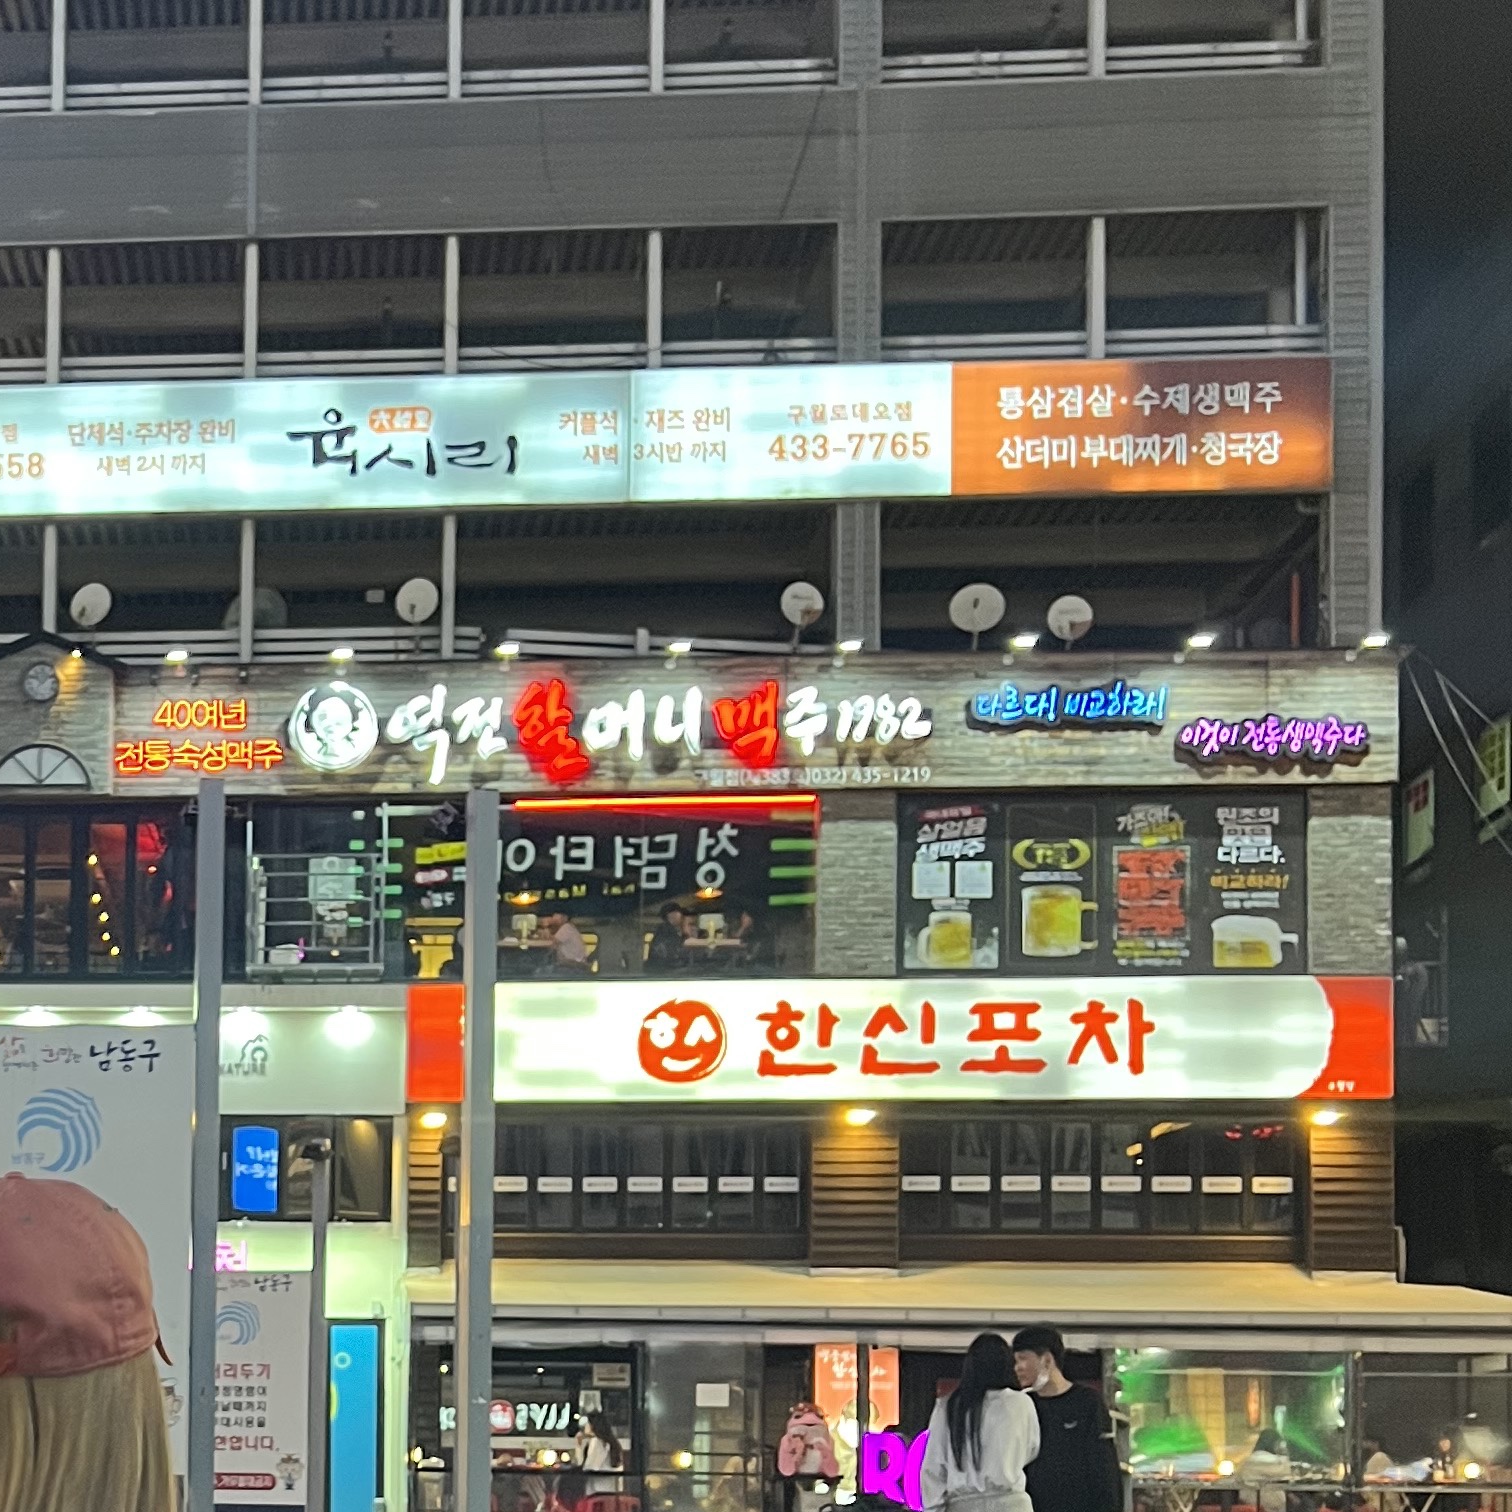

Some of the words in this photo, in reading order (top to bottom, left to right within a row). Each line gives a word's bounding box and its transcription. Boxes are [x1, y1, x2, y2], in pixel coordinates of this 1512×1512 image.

[197, 419, 236, 444] 완비
[558, 409, 619, 437] 커플석
[692, 406, 731, 432] 완비
[690, 441, 727, 463] 까지
[768, 431, 931, 462] 433-7765
[171, 453, 207, 475] 까지
[153, 700, 247, 731] 40여년
[387, 678, 829, 786] 역전할머니맥주
[836, 692, 932, 743] 1982
[852, 766, 931, 784] 435-1219
[755, 999, 1156, 1077] 한신포차
[90, 1039, 161, 1072] 남동구
